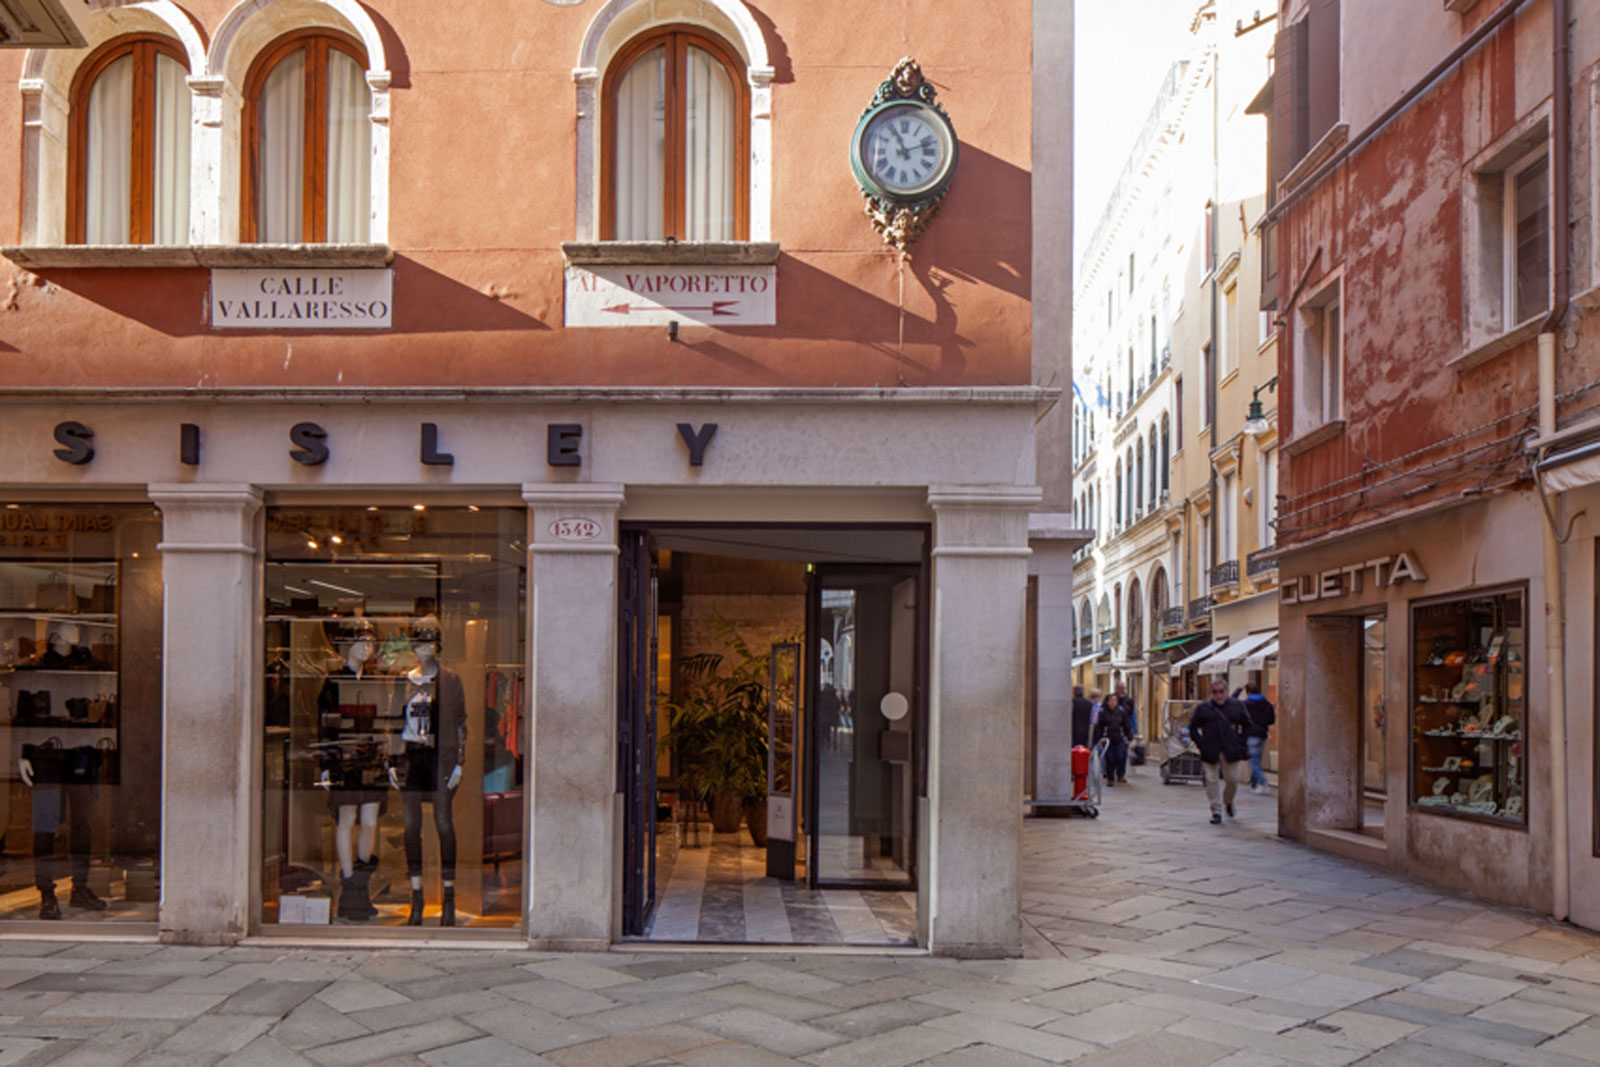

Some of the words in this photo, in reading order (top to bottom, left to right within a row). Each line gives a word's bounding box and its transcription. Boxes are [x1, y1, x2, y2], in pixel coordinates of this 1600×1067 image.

[260, 276, 343, 295] CALLE
[576, 274, 606, 292] AL
[625, 274, 768, 292] VAPORETTO
[218, 300, 388, 319] VALLARESSO
[53, 420, 718, 467] SISLEY
[554, 522, 594, 536] 1542
[1280, 552, 1427, 605] GUETTA
